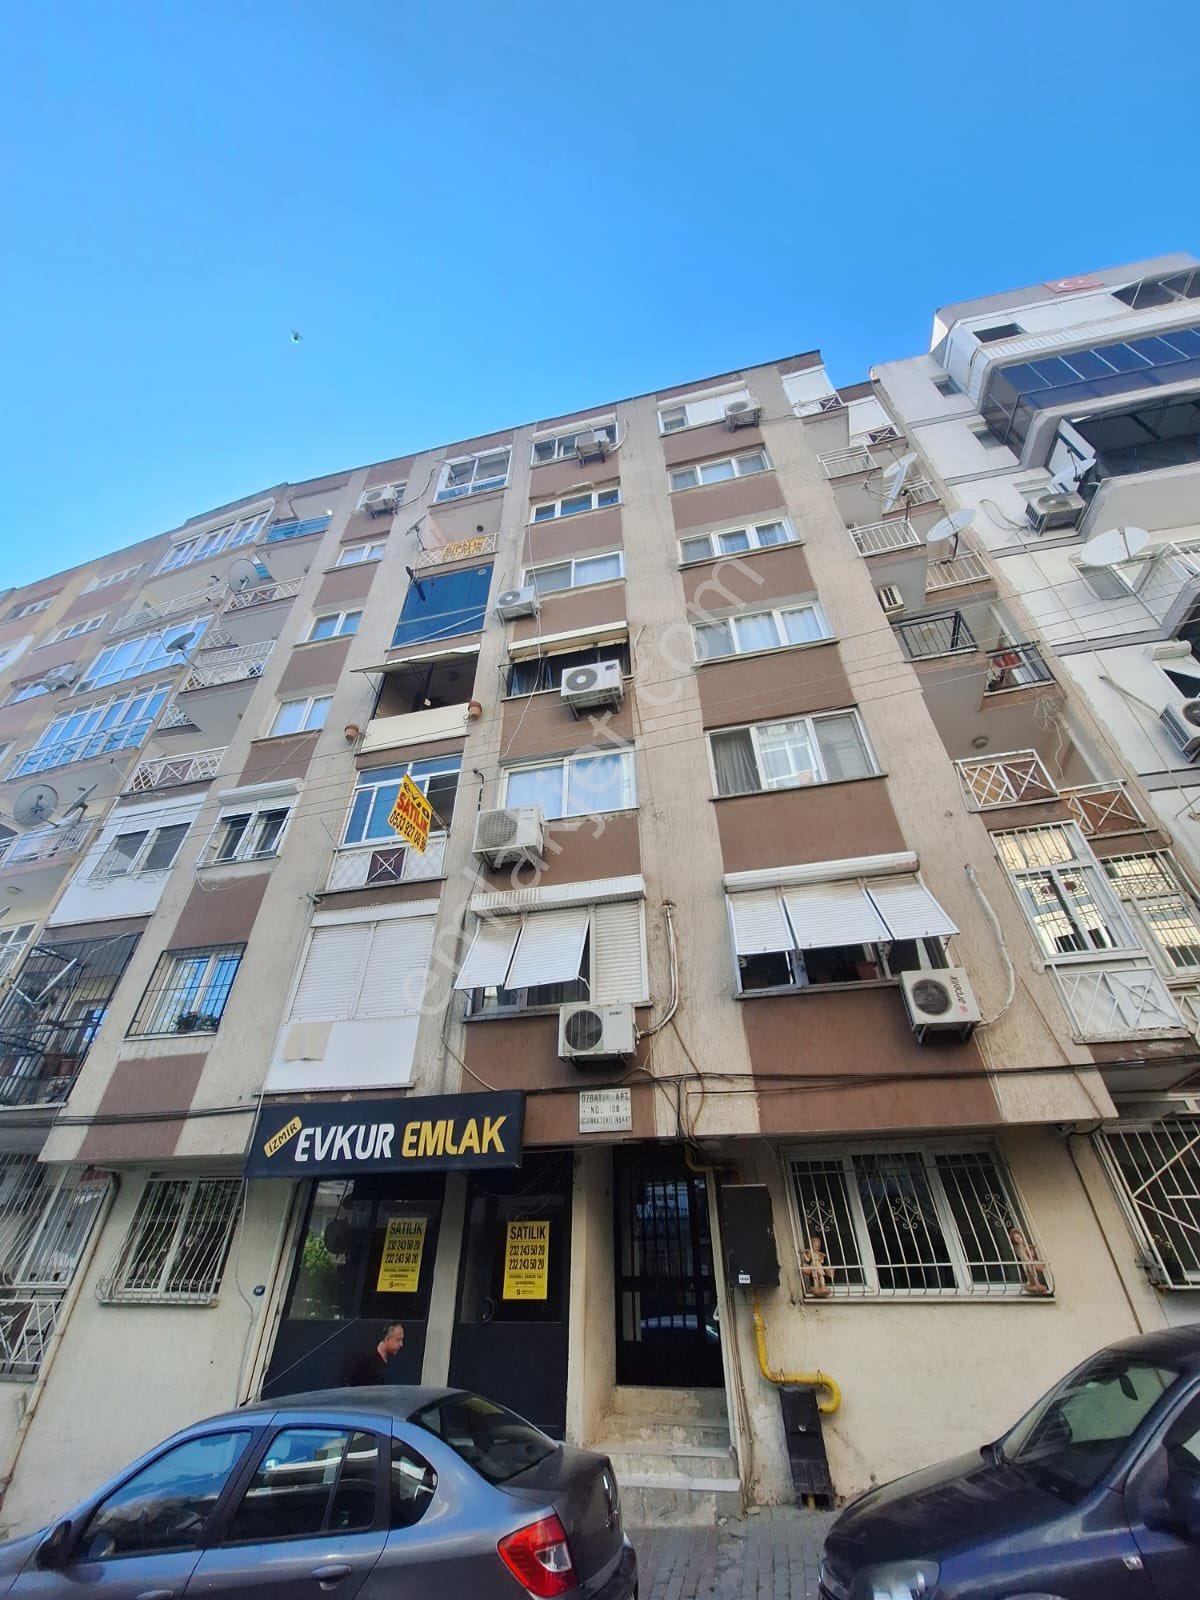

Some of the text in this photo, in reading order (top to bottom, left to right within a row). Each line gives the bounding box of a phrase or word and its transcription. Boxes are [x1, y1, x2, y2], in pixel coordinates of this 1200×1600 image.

[396, 792, 428, 837] SATILIK
[294, 1116, 507, 1162] EVKUR EMLAK
[390, 1221, 423, 1235] SATILIK
[510, 1225, 545, 1240] SATILIK
